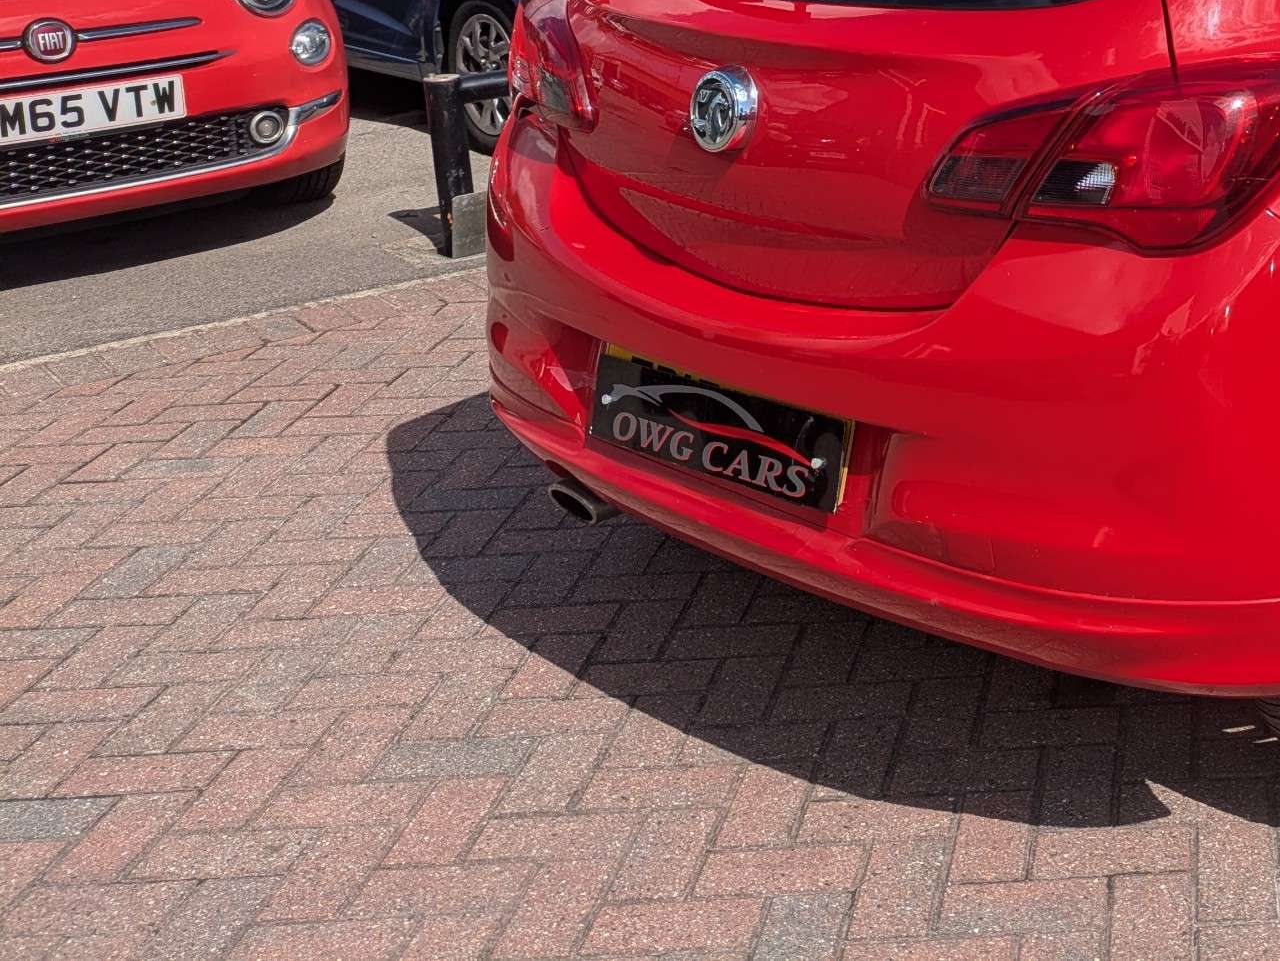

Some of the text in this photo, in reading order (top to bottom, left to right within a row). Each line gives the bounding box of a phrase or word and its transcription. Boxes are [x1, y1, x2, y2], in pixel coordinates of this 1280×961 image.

[38, 31, 65, 52] FIAT
[0, 80, 175, 137] M65 VTW
[612, 412, 809, 498] OWG CARS
